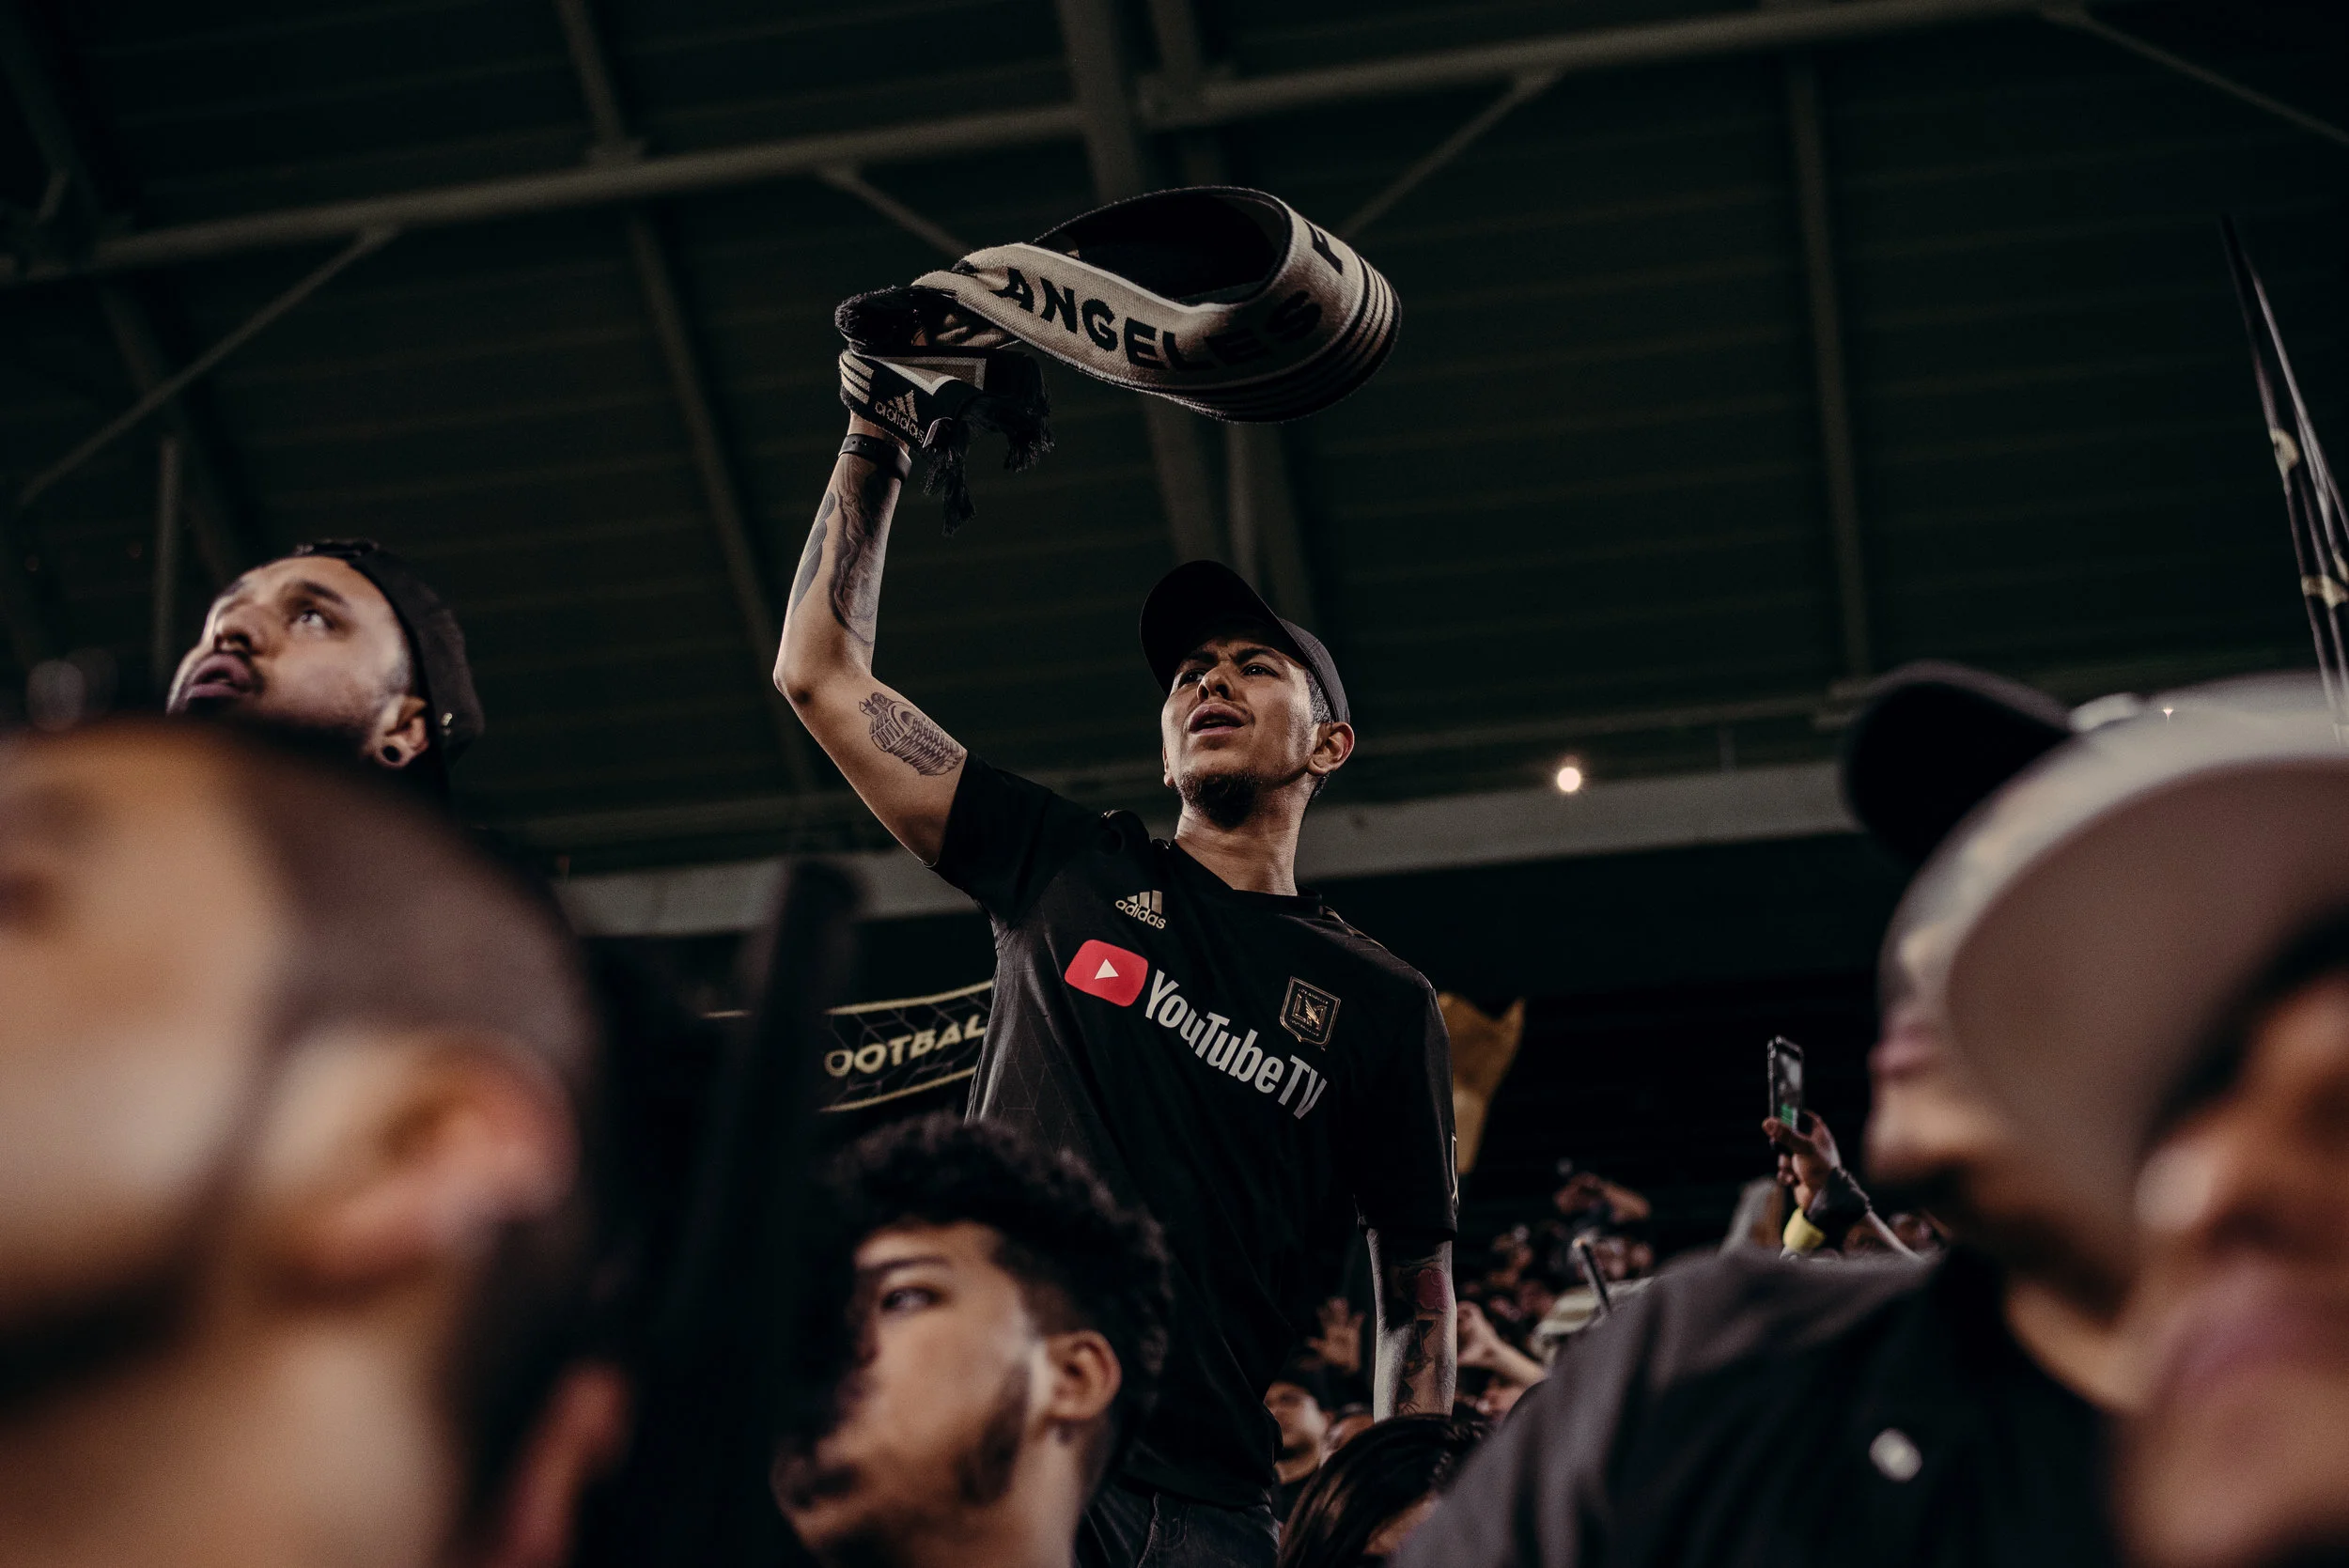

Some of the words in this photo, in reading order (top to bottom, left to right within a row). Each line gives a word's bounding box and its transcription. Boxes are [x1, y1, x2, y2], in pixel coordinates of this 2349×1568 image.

[990, 267, 1322, 372] ANGELES
[874, 400, 925, 443] adidas
[1114, 899, 1167, 929] adidas
